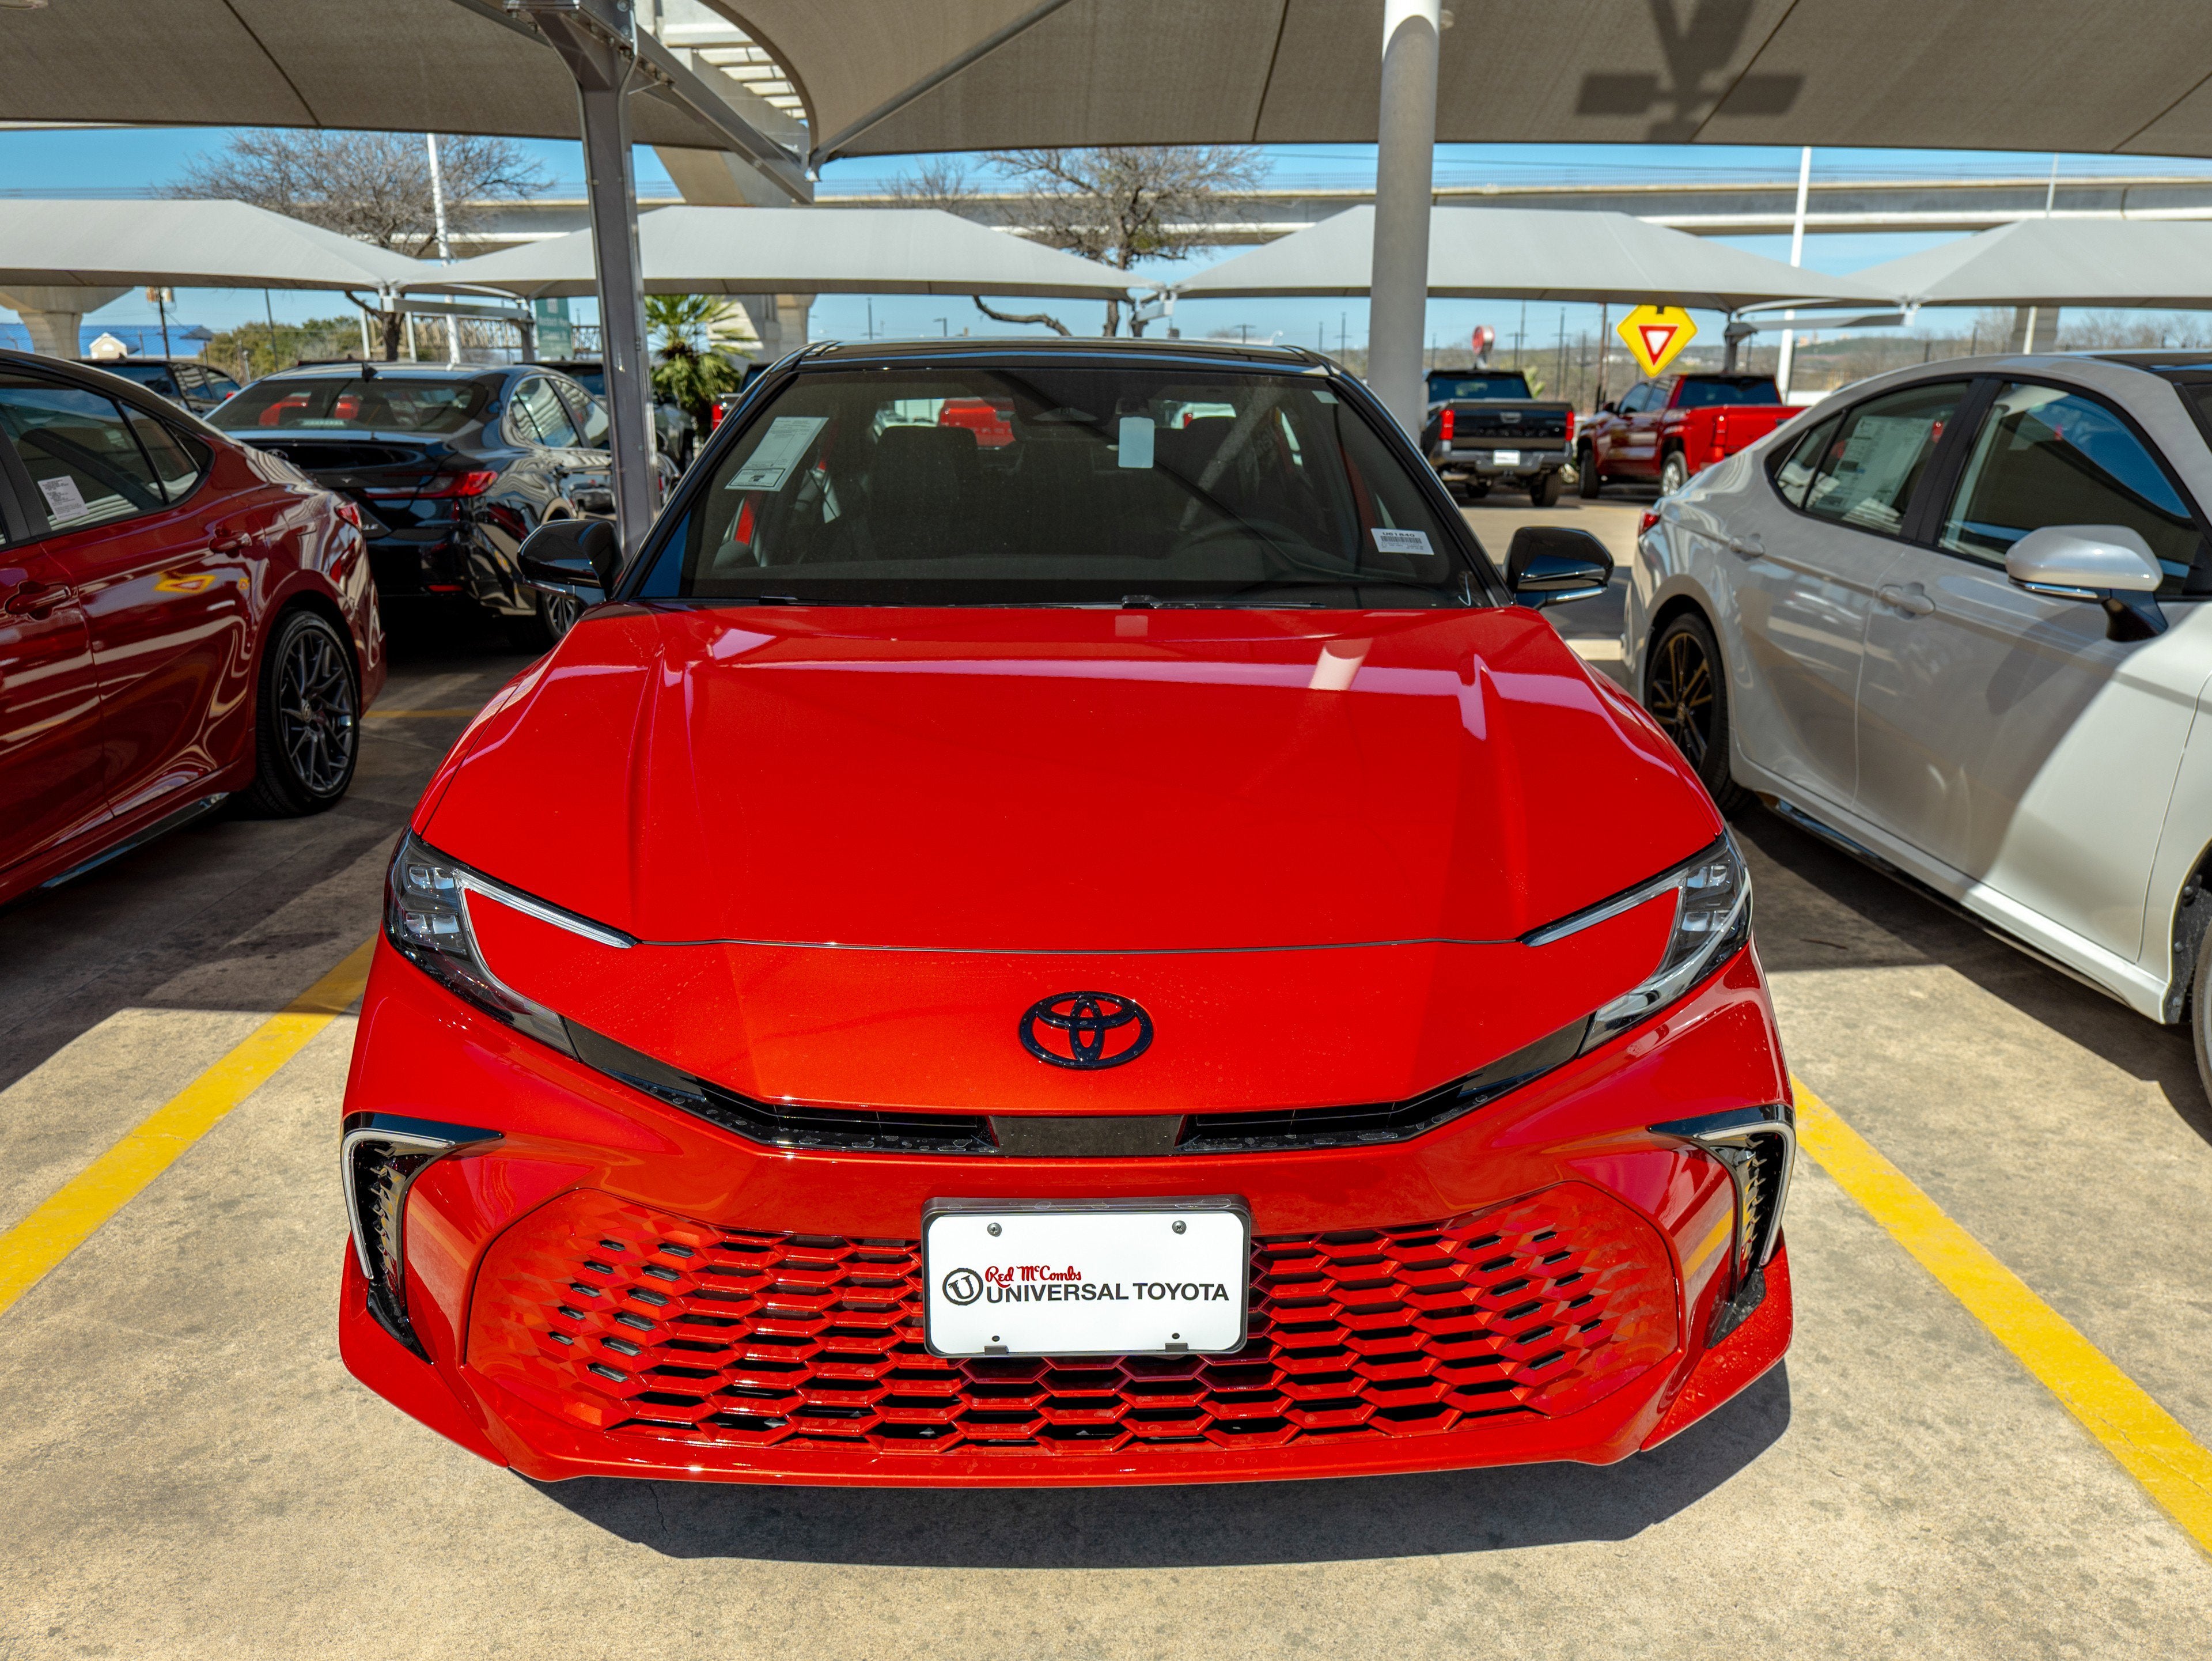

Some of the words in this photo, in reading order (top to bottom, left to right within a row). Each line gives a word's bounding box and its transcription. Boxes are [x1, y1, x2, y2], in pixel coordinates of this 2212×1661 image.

[984, 1265, 1014, 1288] Red
[1016, 1265, 1082, 1281] McCombs
[986, 1283, 1129, 1304] UNIVERSAL
[1132, 1282, 1230, 1301] TOYOTA
